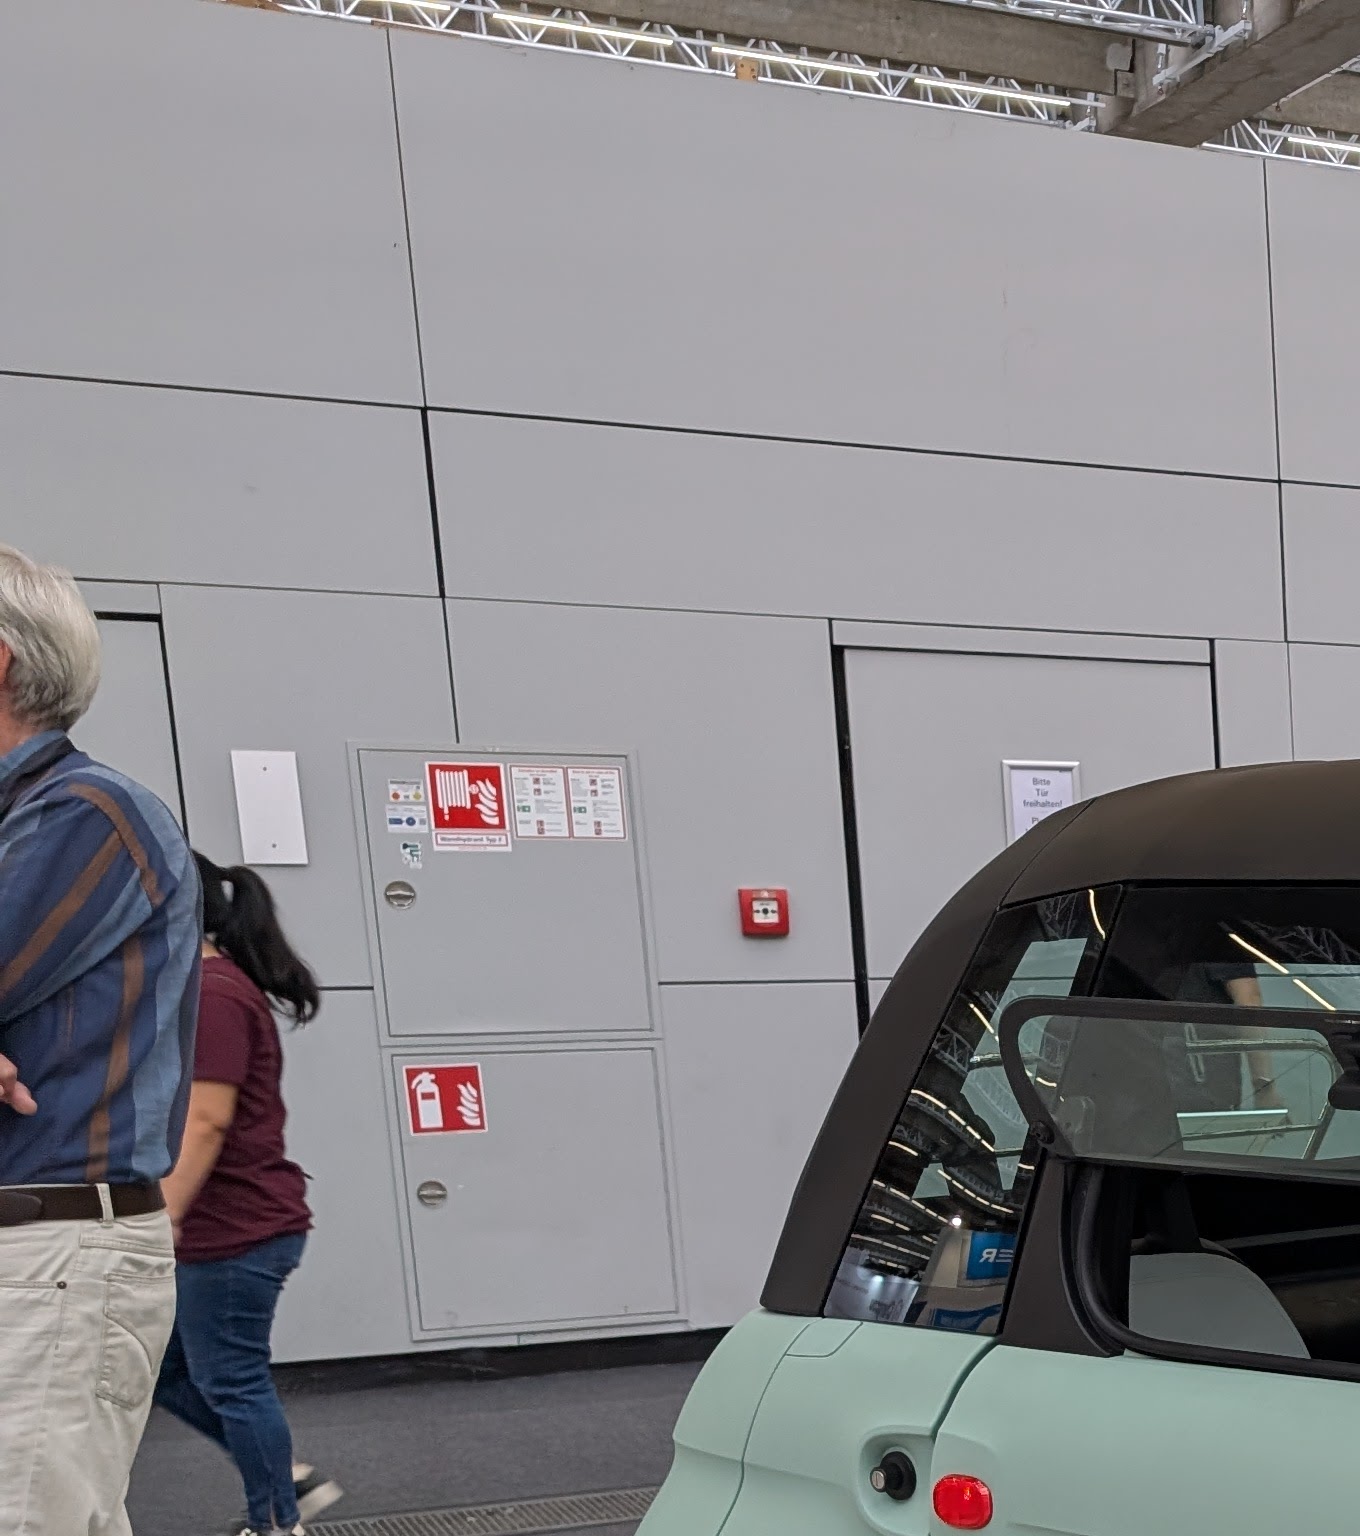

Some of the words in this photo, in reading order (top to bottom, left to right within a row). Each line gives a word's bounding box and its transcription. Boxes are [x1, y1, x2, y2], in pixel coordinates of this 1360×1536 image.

[1032, 777, 1051, 786] Bitte
[1035, 788, 1049, 797] Tür
[1023, 800, 1062, 808] freihalten!
